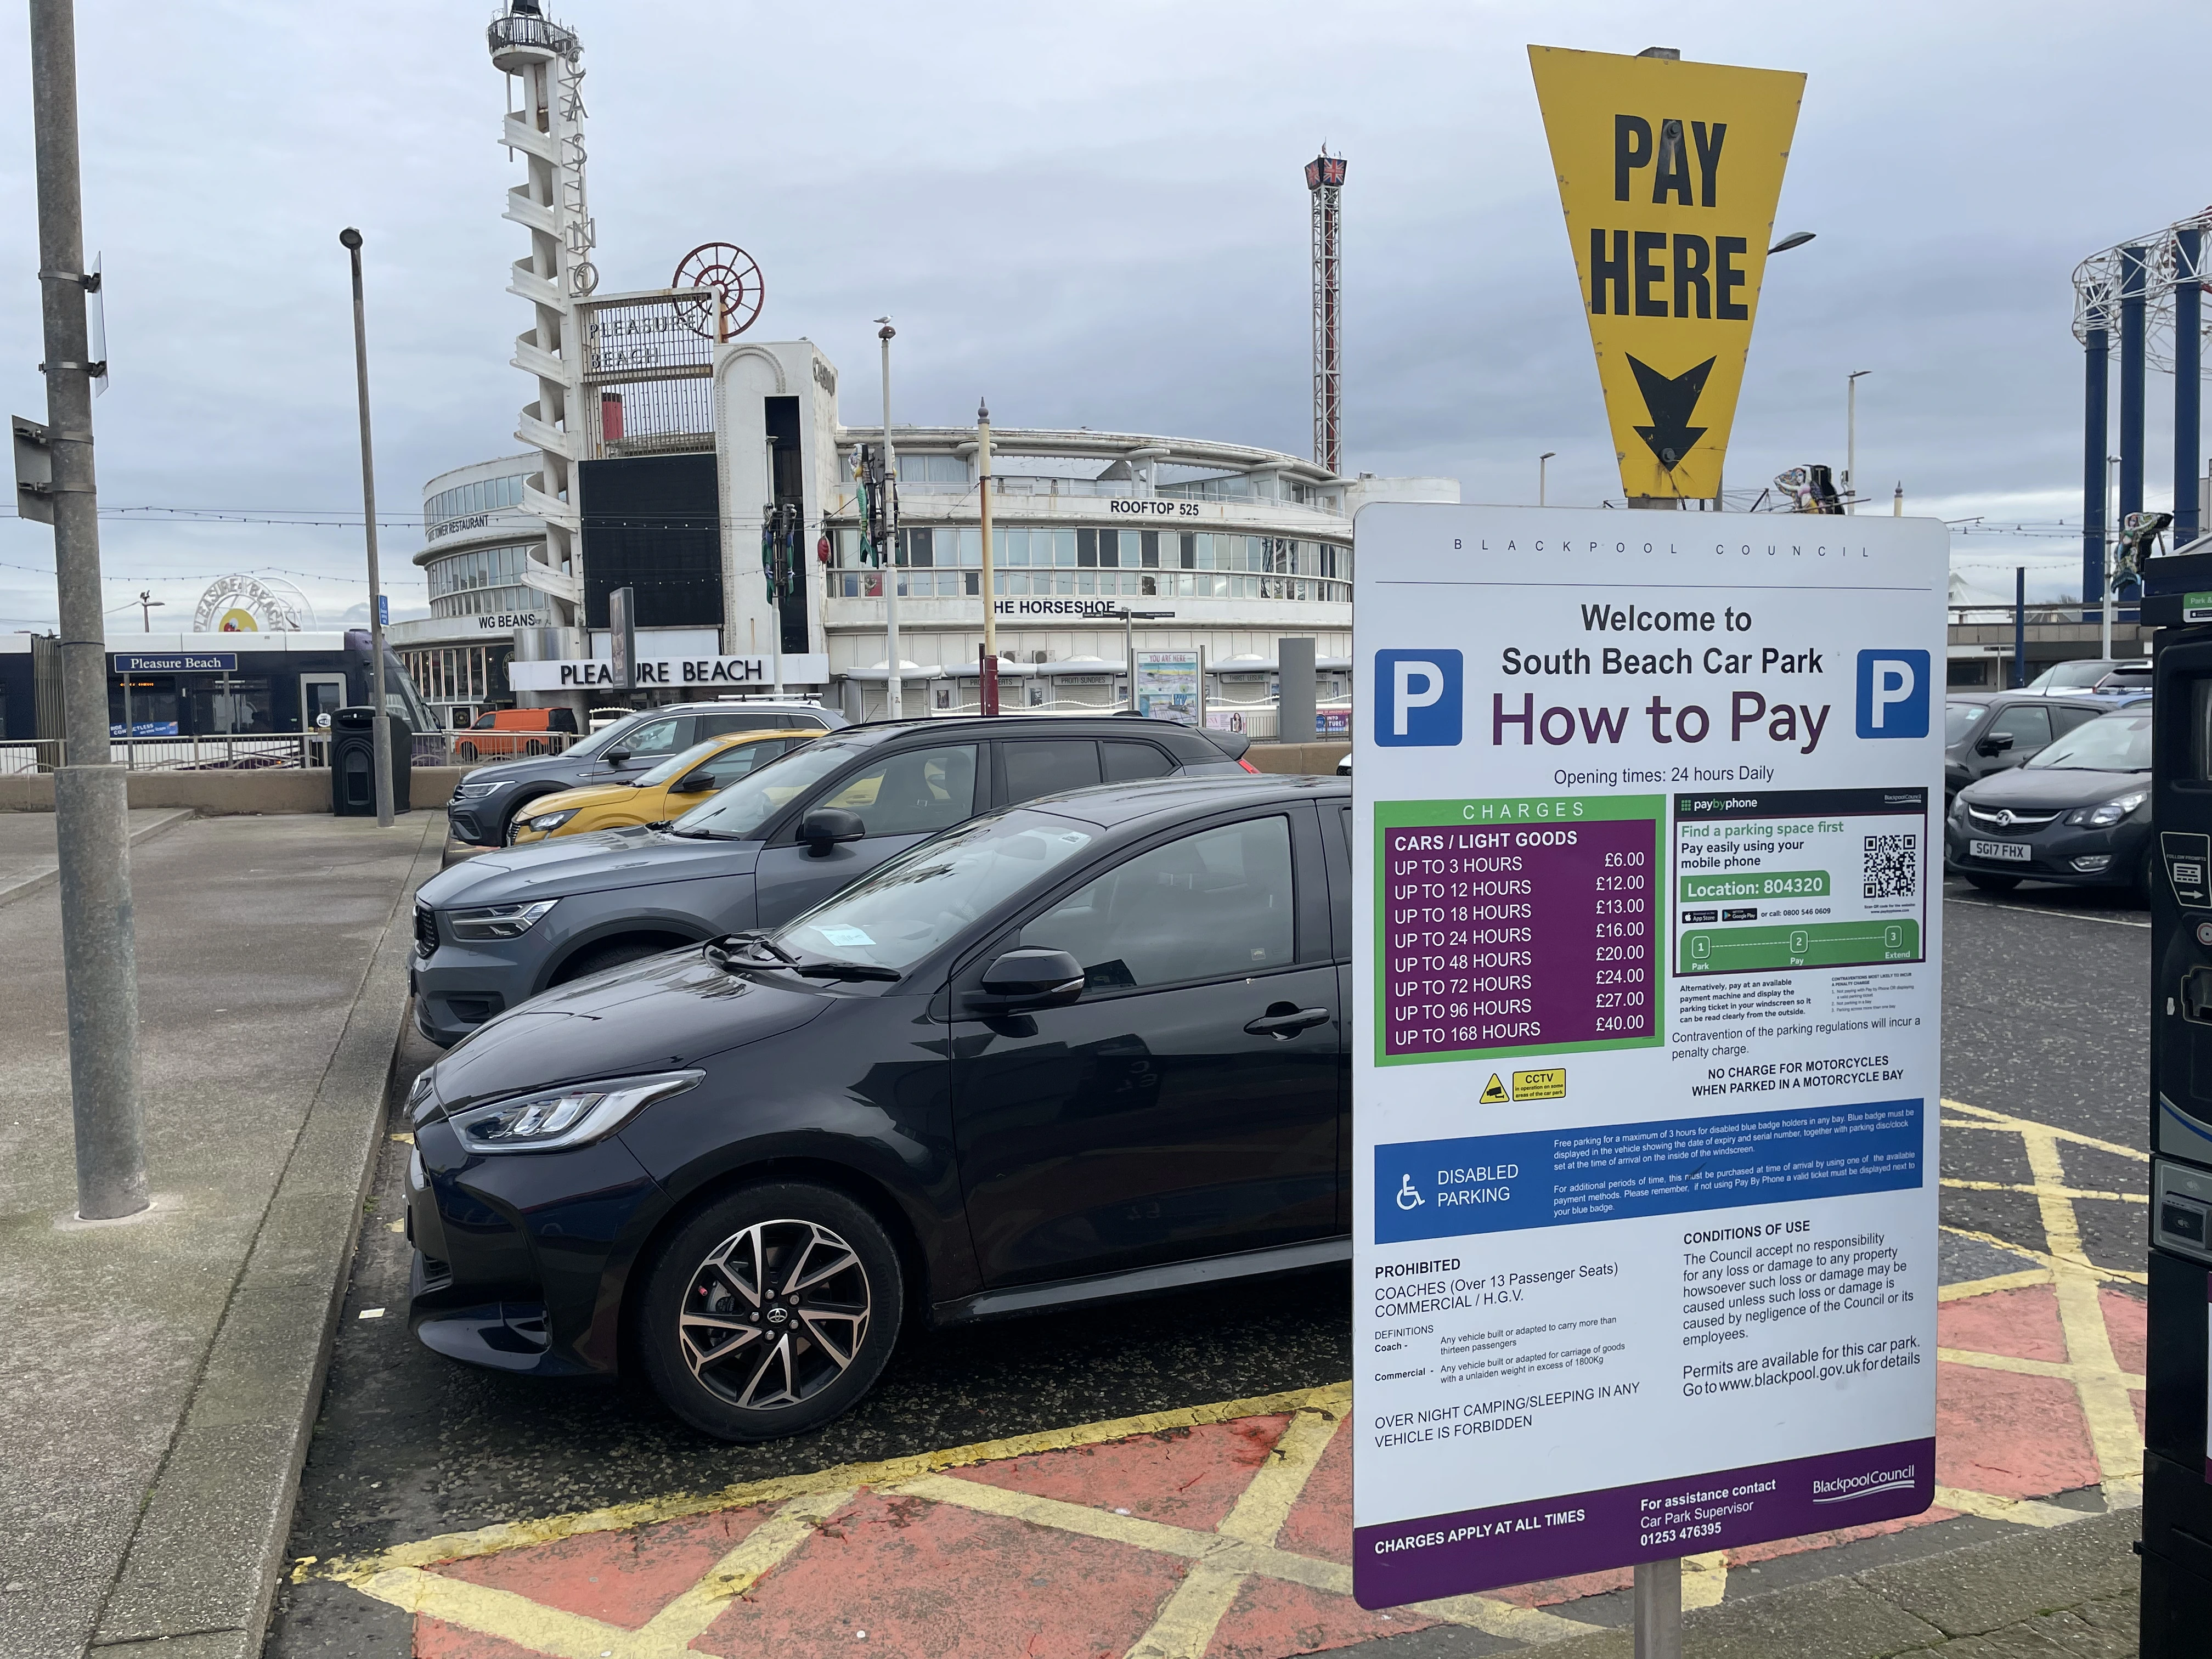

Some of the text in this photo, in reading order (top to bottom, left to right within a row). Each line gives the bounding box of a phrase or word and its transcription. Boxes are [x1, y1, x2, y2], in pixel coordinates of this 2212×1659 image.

[566, 46, 599, 293] CASINO
[1615, 114, 1727, 207] PAY
[1591, 228, 1748, 320] HERE
[589, 314, 696, 339] PLEASURE
[591, 347, 658, 369] BEACH
[1110, 500, 1198, 516] ROOFTOP 525
[449, 515, 488, 534] RESTAURANT
[994, 601, 1115, 614] HE HORSESHOE
[1581, 604, 1751, 631] Welcome to
[478, 613, 535, 629] WG BEANS
[131, 657, 221, 668] Pleasure Beach
[1149, 654, 1160, 663] YOU
[1502, 647, 1823, 675] South Beach Car Park
[682, 660, 761, 682] BEACH
[1393, 661, 1444, 736] P
[1871, 660, 1915, 728] P
[1493, 691, 1831, 754] How to Pay
[1554, 765, 1774, 787] Opening times: 24 hours Daily
[1463, 802, 1583, 819] CHARGES
[1694, 798, 1757, 811] paybyphone
[1682, 821, 1844, 839] Find a parking space first
[1395, 831, 1577, 851] CARS / LIGHT GOODS
[1681, 840, 1804, 856] Pay easily using your
[1976, 843, 2024, 858] SG17 FHX
[1395, 851, 1644, 876] UP TO 3 HOURS £6.00
[1681, 856, 1760, 870] mobile phone
[1395, 875, 1644, 900] UP TO 12 HOURS £12.00
[1688, 877, 1822, 897] Location: 804320
[1395, 898, 1644, 924] UP TO 18 HOURS £13.00
[1699, 943, 1703, 951] 1
[1797, 938, 1802, 946] 2
[1891, 933, 1896, 941] 3
[1790, 957, 1804, 966] Pay
[1885, 951, 1910, 959] Extend
[1692, 962, 1709, 970] Park
[1396, 1015, 1644, 1045] UP TO 168 HOURS £40.00
[1708, 1056, 1888, 1079] NO CHARGE FOR MOTORCYCLES
[1525, 1073, 1554, 1084] CCTV
[1438, 1164, 1518, 1185] DISABLED
[1438, 1186, 1510, 1207] PARKING
[1554, 1203, 1615, 1218] your blue badge.
[1684, 1220, 1810, 1244] CONDITIONS OF USE
[1375, 1259, 1460, 1279] PROHIBITED
[1375, 1263, 1617, 1300] COACHES (Over 13 Passenger Seats)
[1375, 1289, 1523, 1317] COMMERCIAL / H.G.V.
[1375, 1324, 1433, 1340] DEFINITIONS
[1641, 1479, 1776, 1511] For assistance contact
[1641, 1502, 1754, 1528] Car Park Supervisor
[1375, 1510, 1584, 1554] CHARGES APPLY AT ALL TIMES
[1641, 1522, 1721, 1546] 01253 476395
